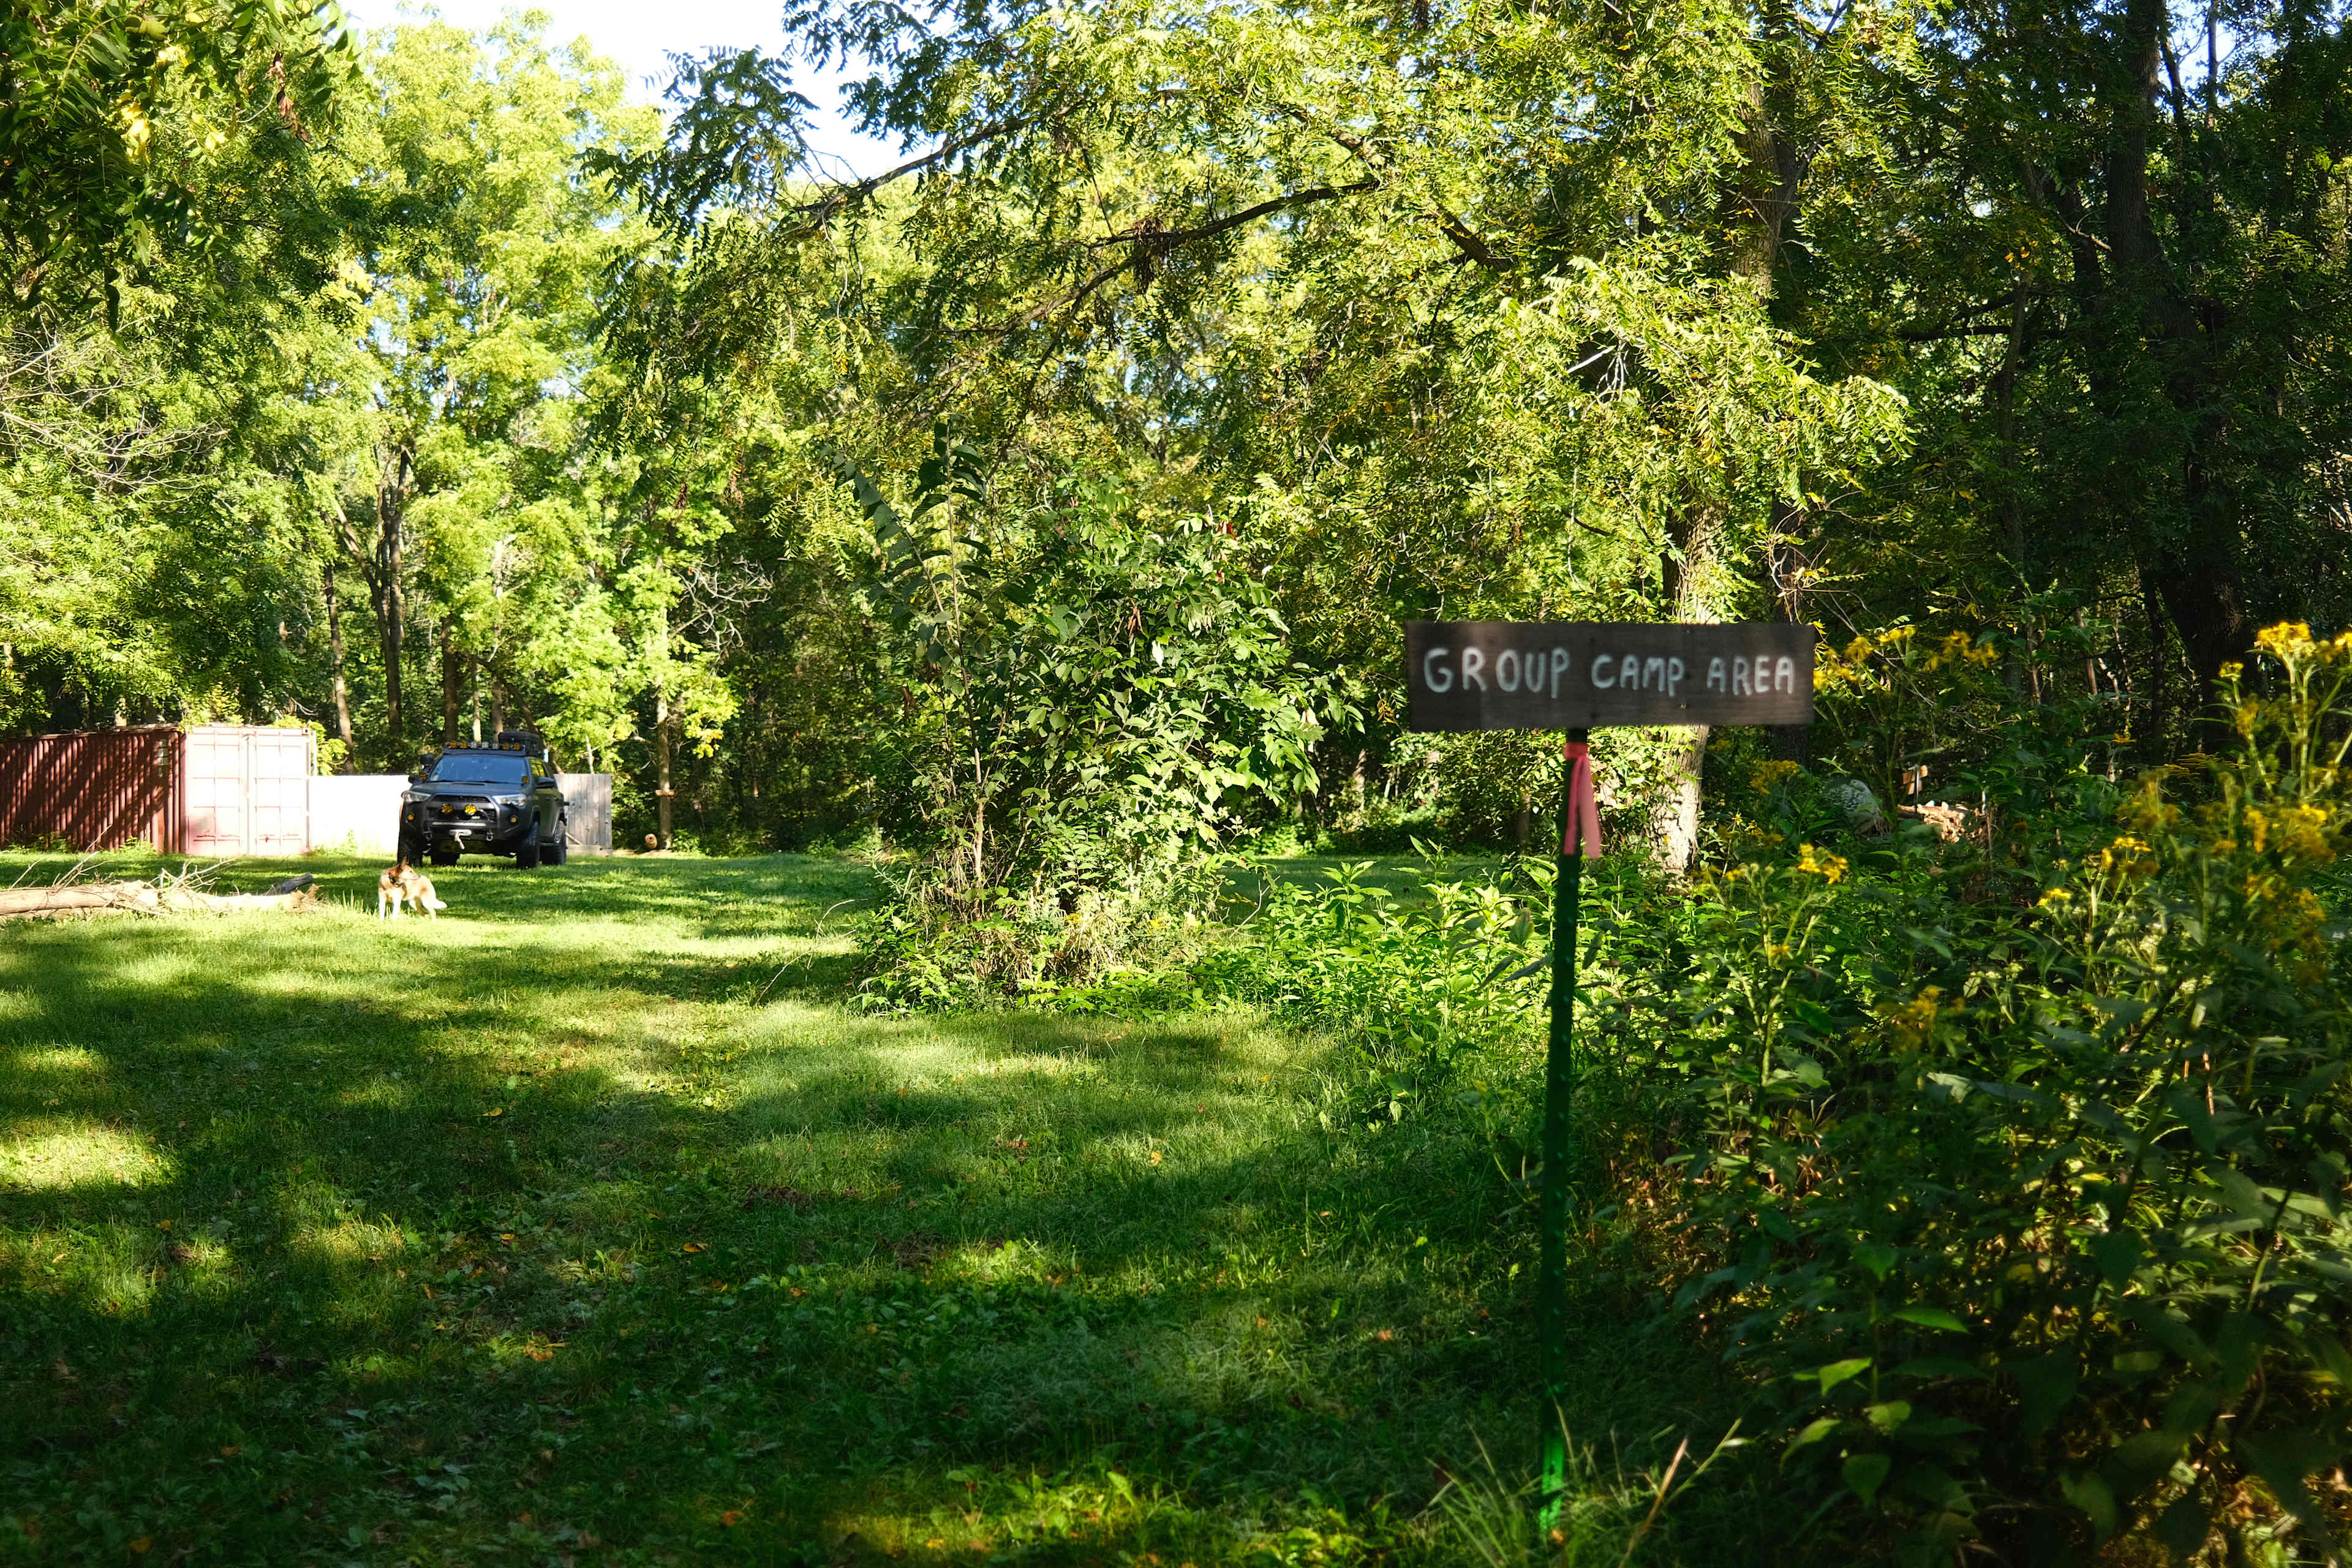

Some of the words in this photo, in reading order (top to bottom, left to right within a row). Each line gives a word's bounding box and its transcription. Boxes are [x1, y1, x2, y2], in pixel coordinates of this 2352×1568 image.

[1423, 647, 1570, 699] GROUP
[1591, 654, 1685, 696] CAMP
[1707, 655, 1795, 696] AREA
